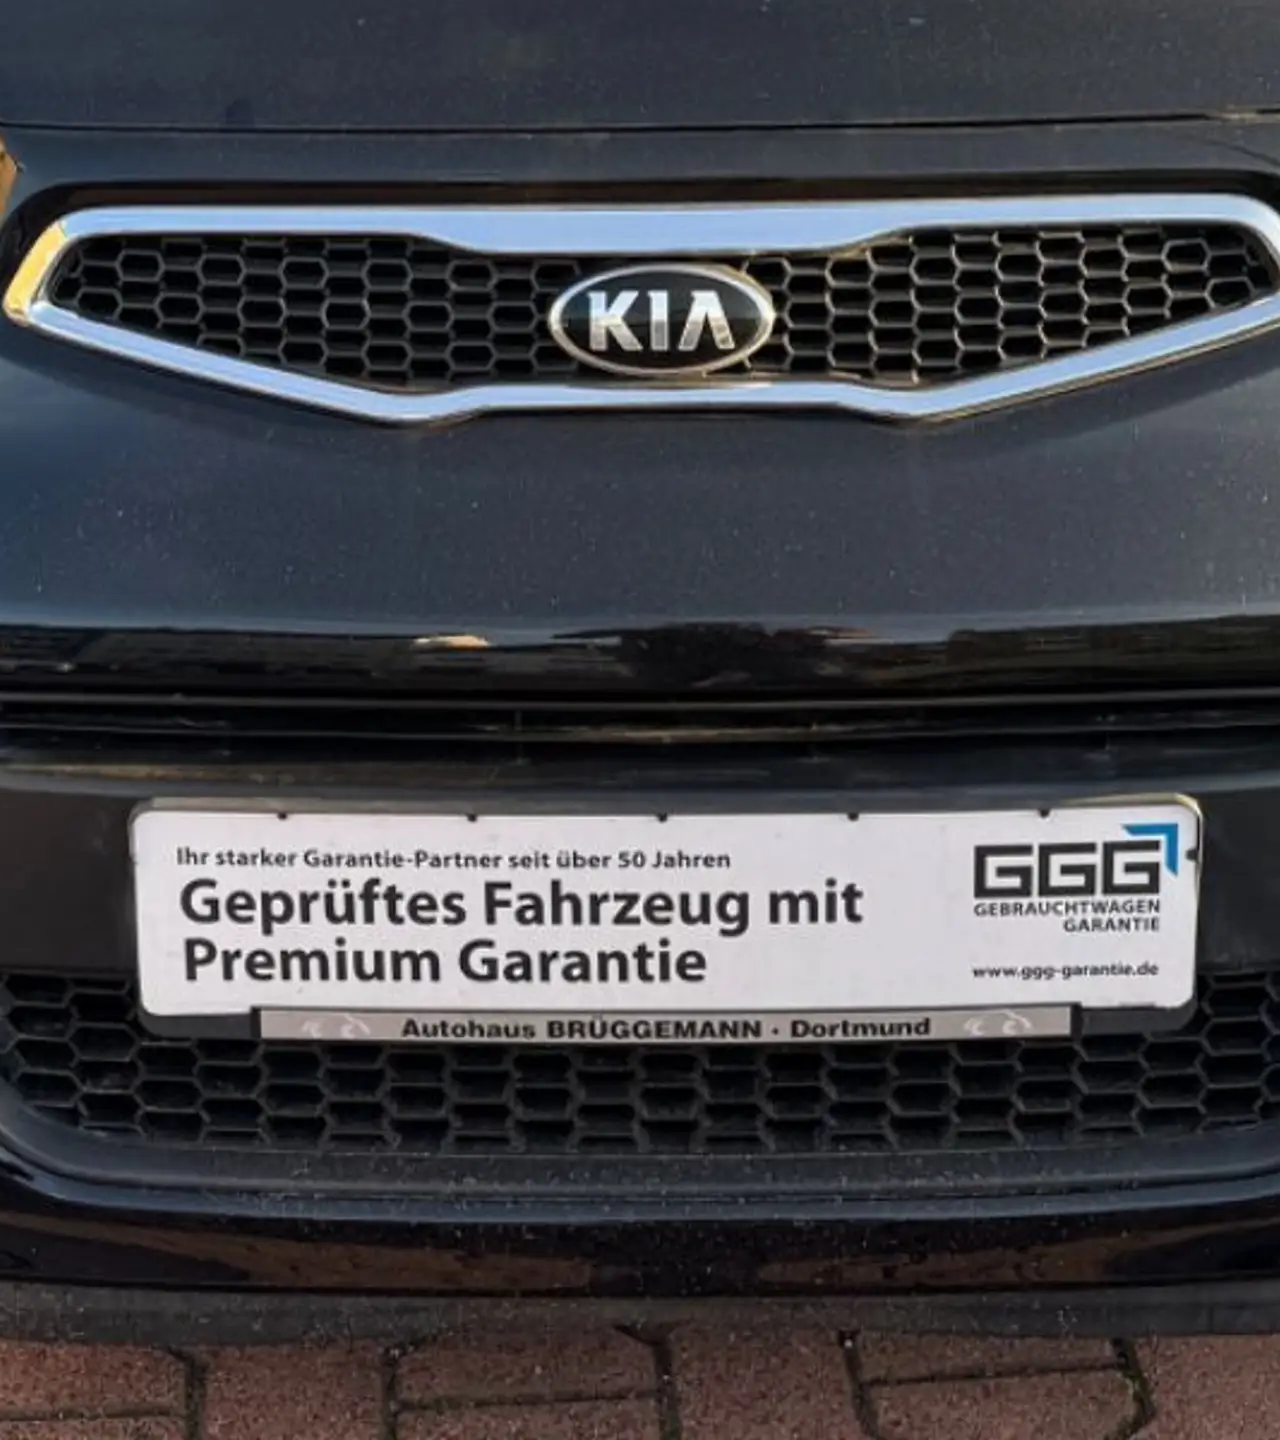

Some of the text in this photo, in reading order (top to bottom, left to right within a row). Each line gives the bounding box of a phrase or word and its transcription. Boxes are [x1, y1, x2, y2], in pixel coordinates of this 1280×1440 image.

[586, 289, 736, 352] KIA
[176, 846, 731, 870] Ihr starker Garantie-Partner seit über 50 Jahren
[974, 839, 1162, 899] GGG
[180, 876, 865, 938] Geprüftes Fahrzeug mit
[973, 899, 1161, 917] GEBRAUCHTWAGEN
[1063, 916, 1161, 933] GARANTIE
[184, 936, 708, 984] Premium Garantie
[972, 960, 1160, 982] www.ggg-garantie.de
[401, 1014, 933, 1040] Autohaus BRÜGGEMANN Dortmund
